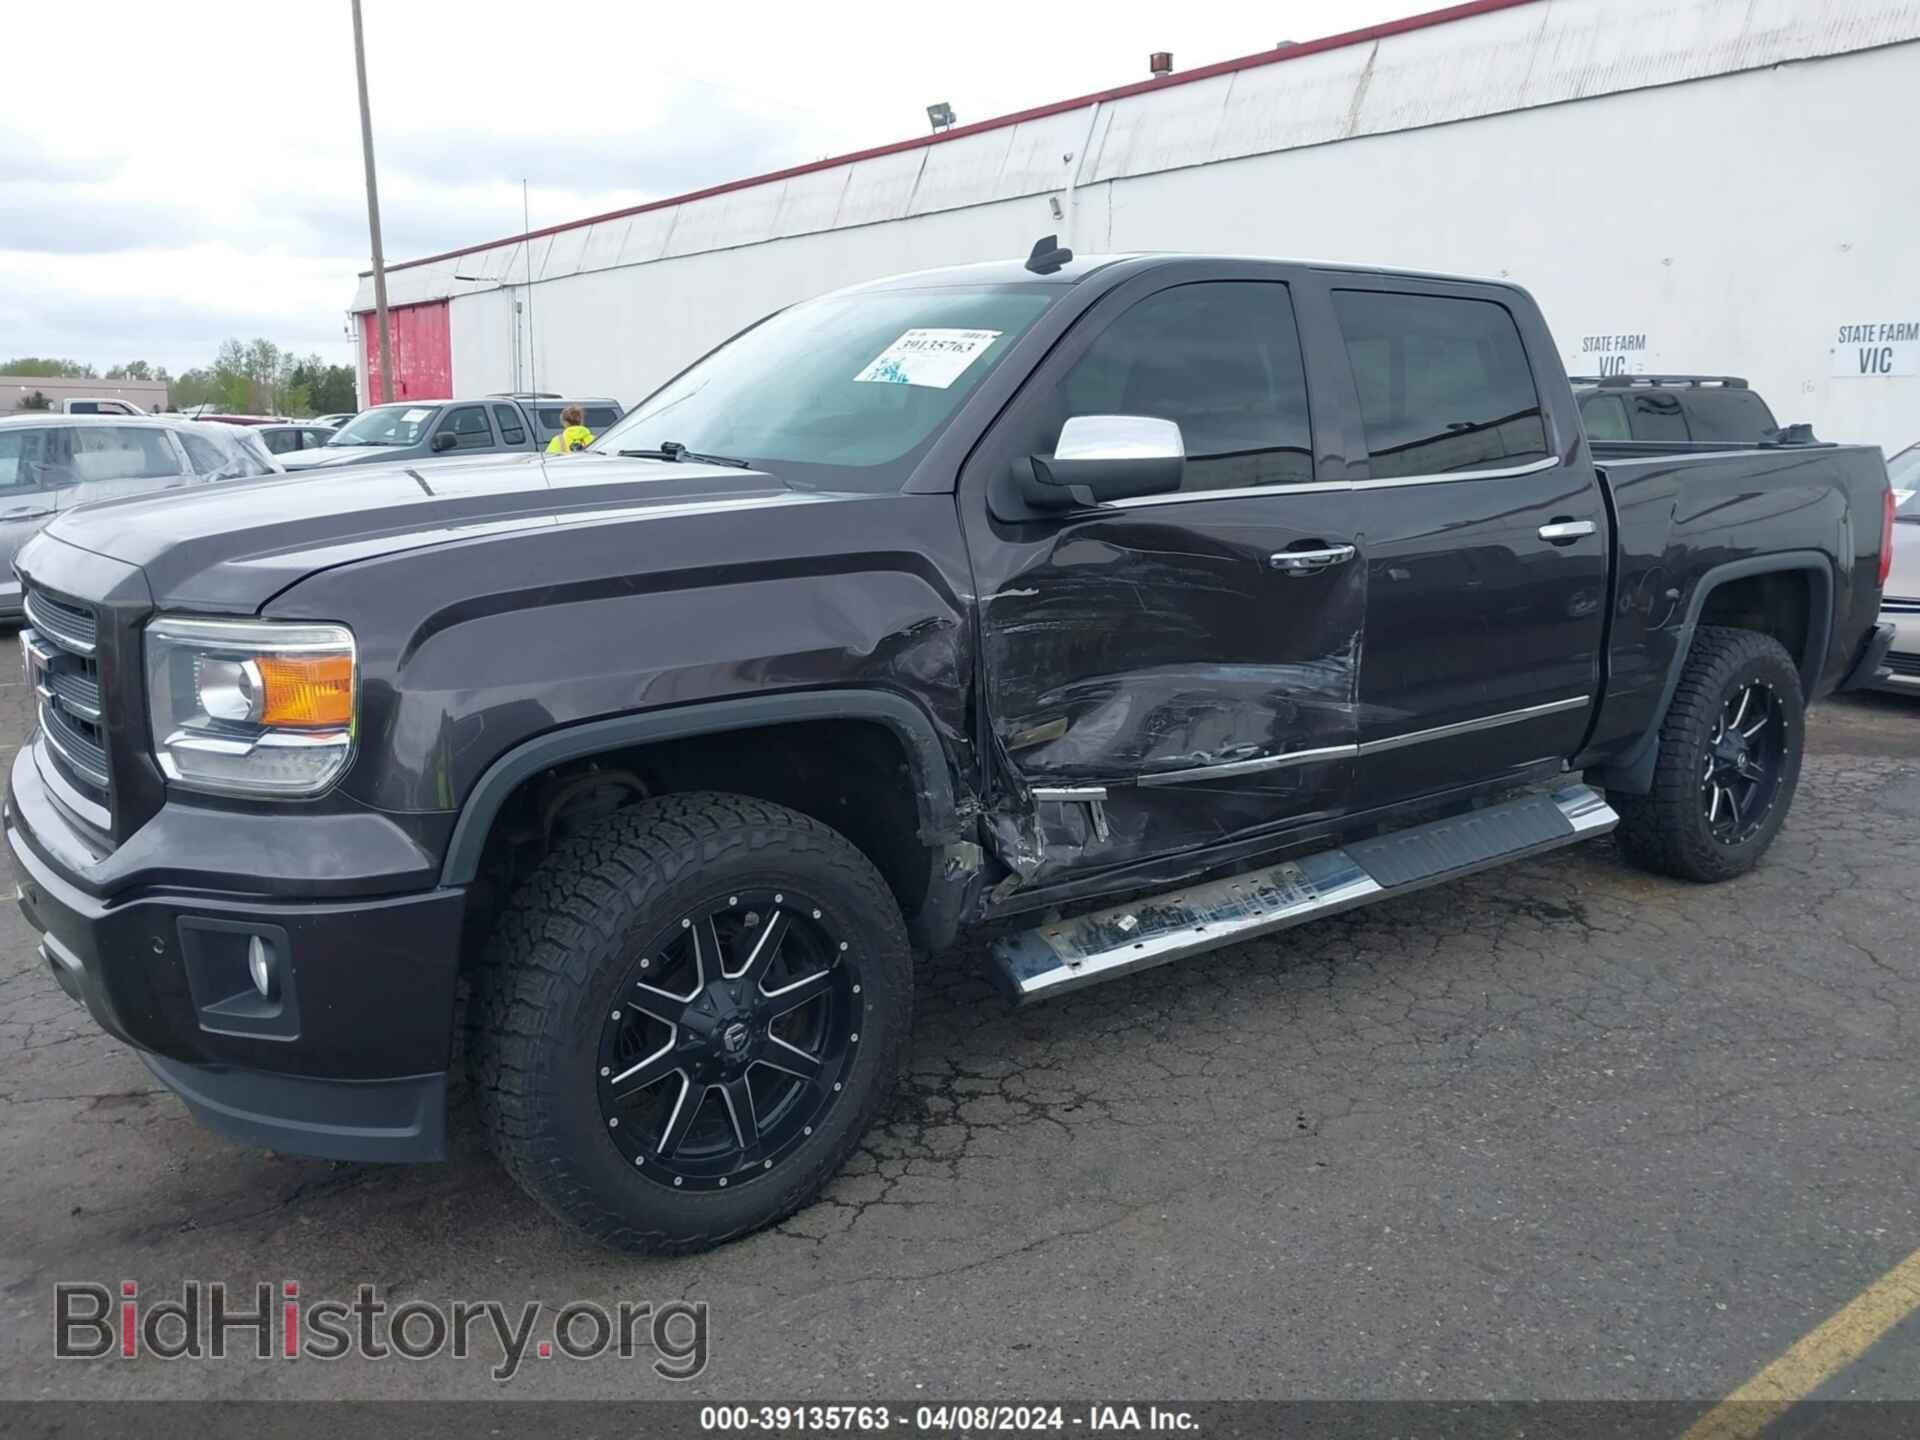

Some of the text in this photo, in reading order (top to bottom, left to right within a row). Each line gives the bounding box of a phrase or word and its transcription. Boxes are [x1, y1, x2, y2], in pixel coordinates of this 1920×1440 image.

[1582, 334, 1647, 353] STATE FARM
[1838, 322, 1919, 344] STATE FARM
[1599, 355, 1625, 377] VIC
[1859, 346, 1893, 374] VIC
